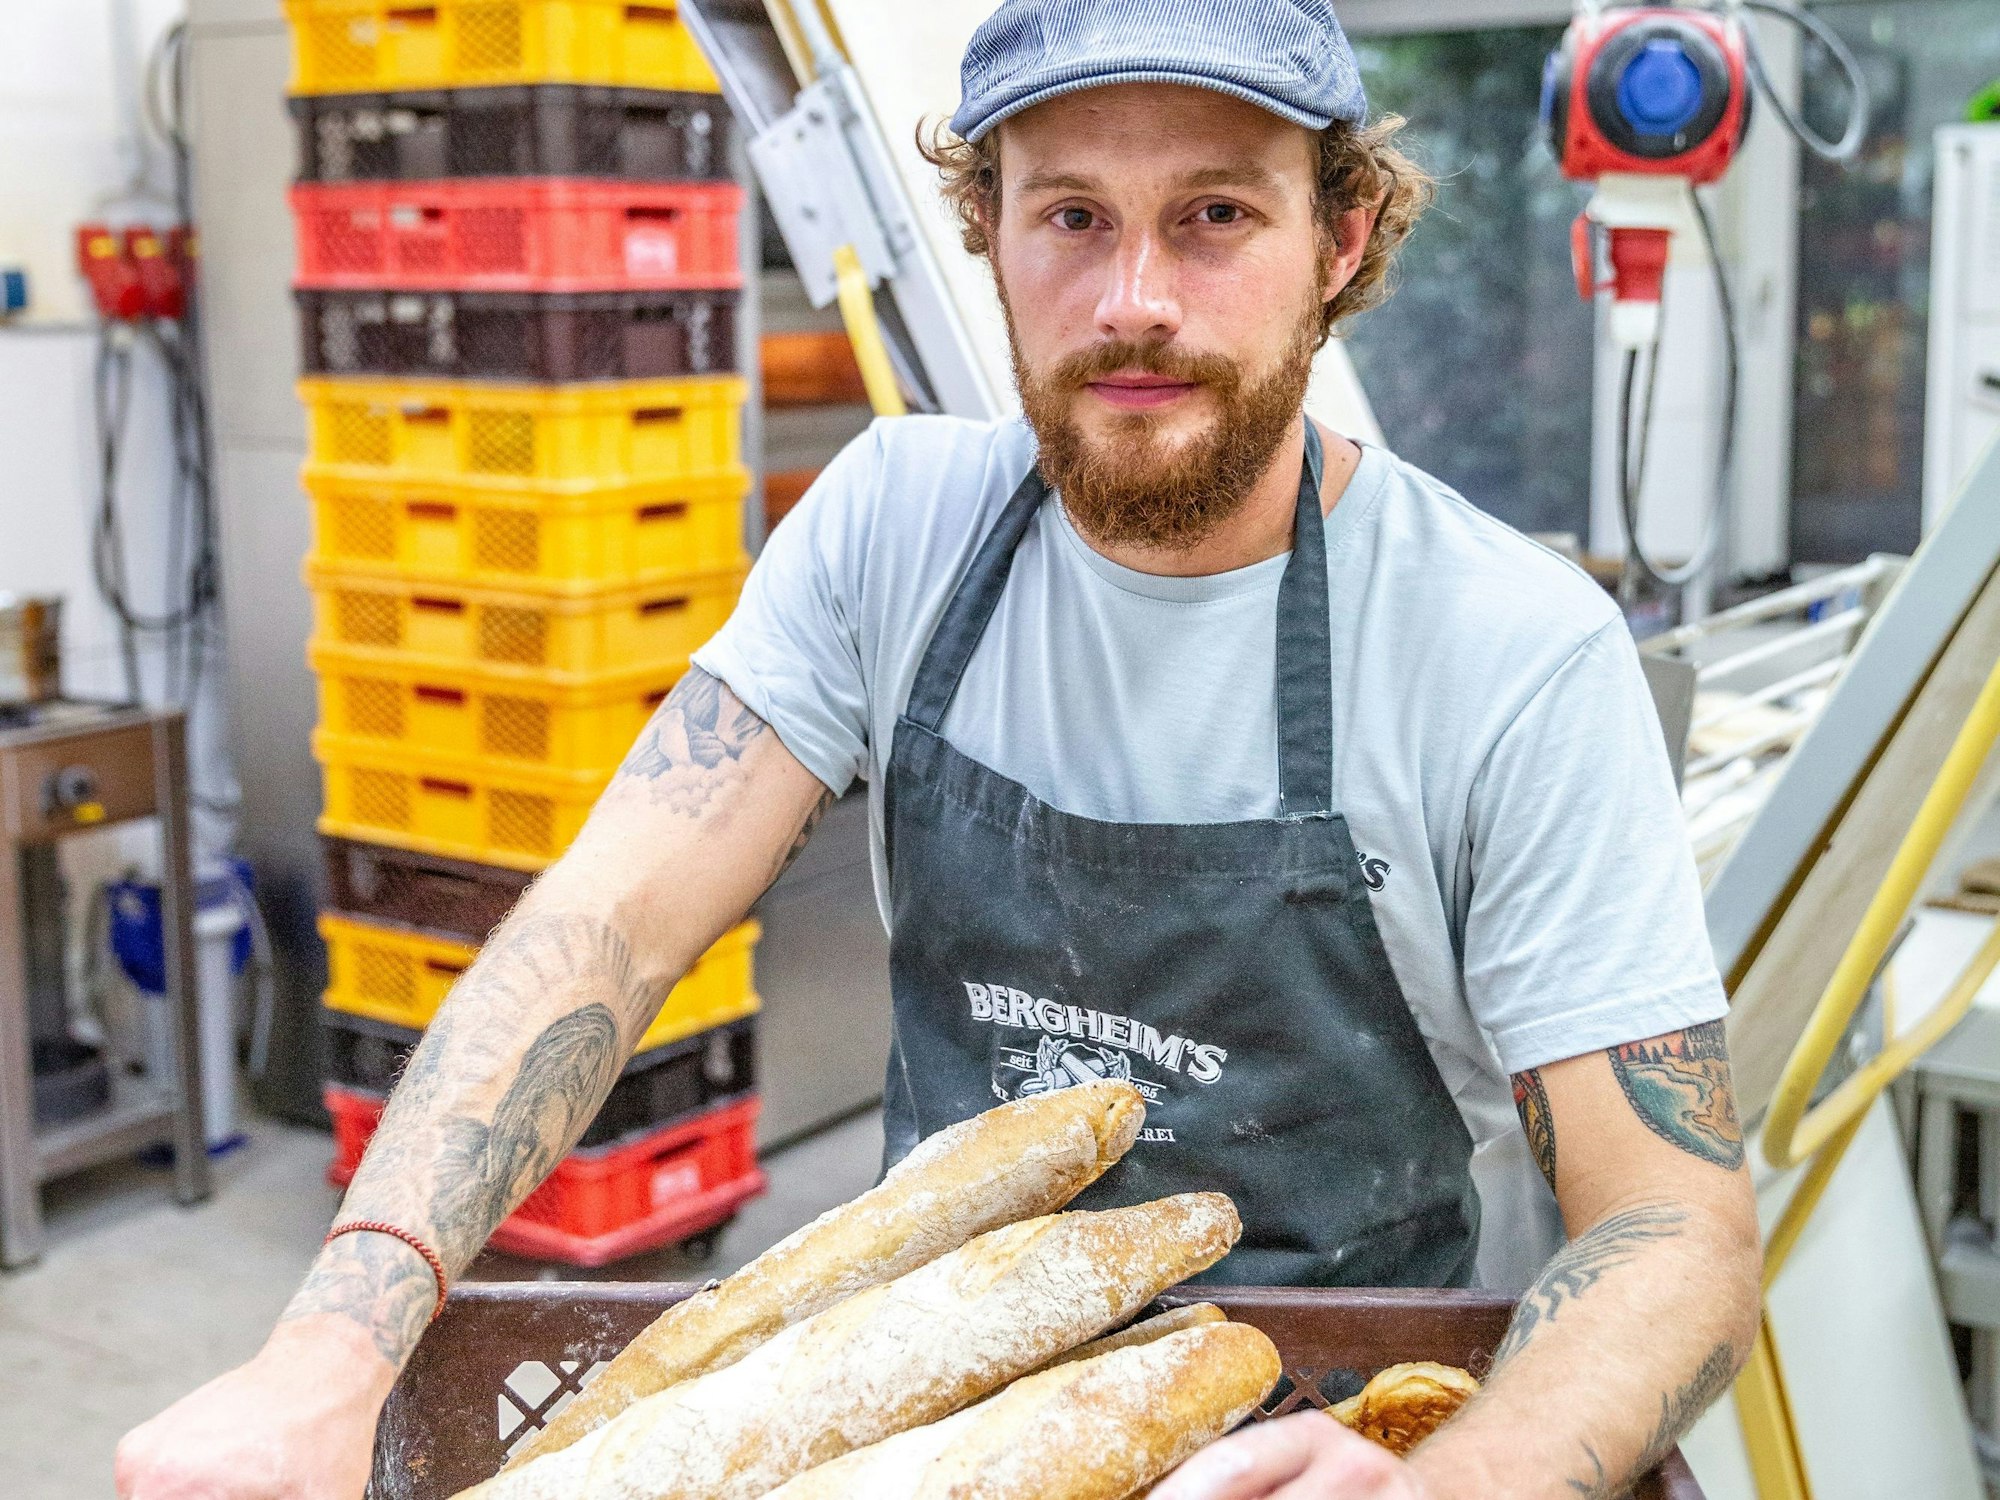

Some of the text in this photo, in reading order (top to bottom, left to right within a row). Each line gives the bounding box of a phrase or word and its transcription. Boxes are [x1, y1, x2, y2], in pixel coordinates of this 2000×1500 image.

[1356, 850, 1391, 892] 'S
[962, 981, 1228, 1084] BERGHEIM'S
[1009, 1054, 1159, 1098] seit 985
